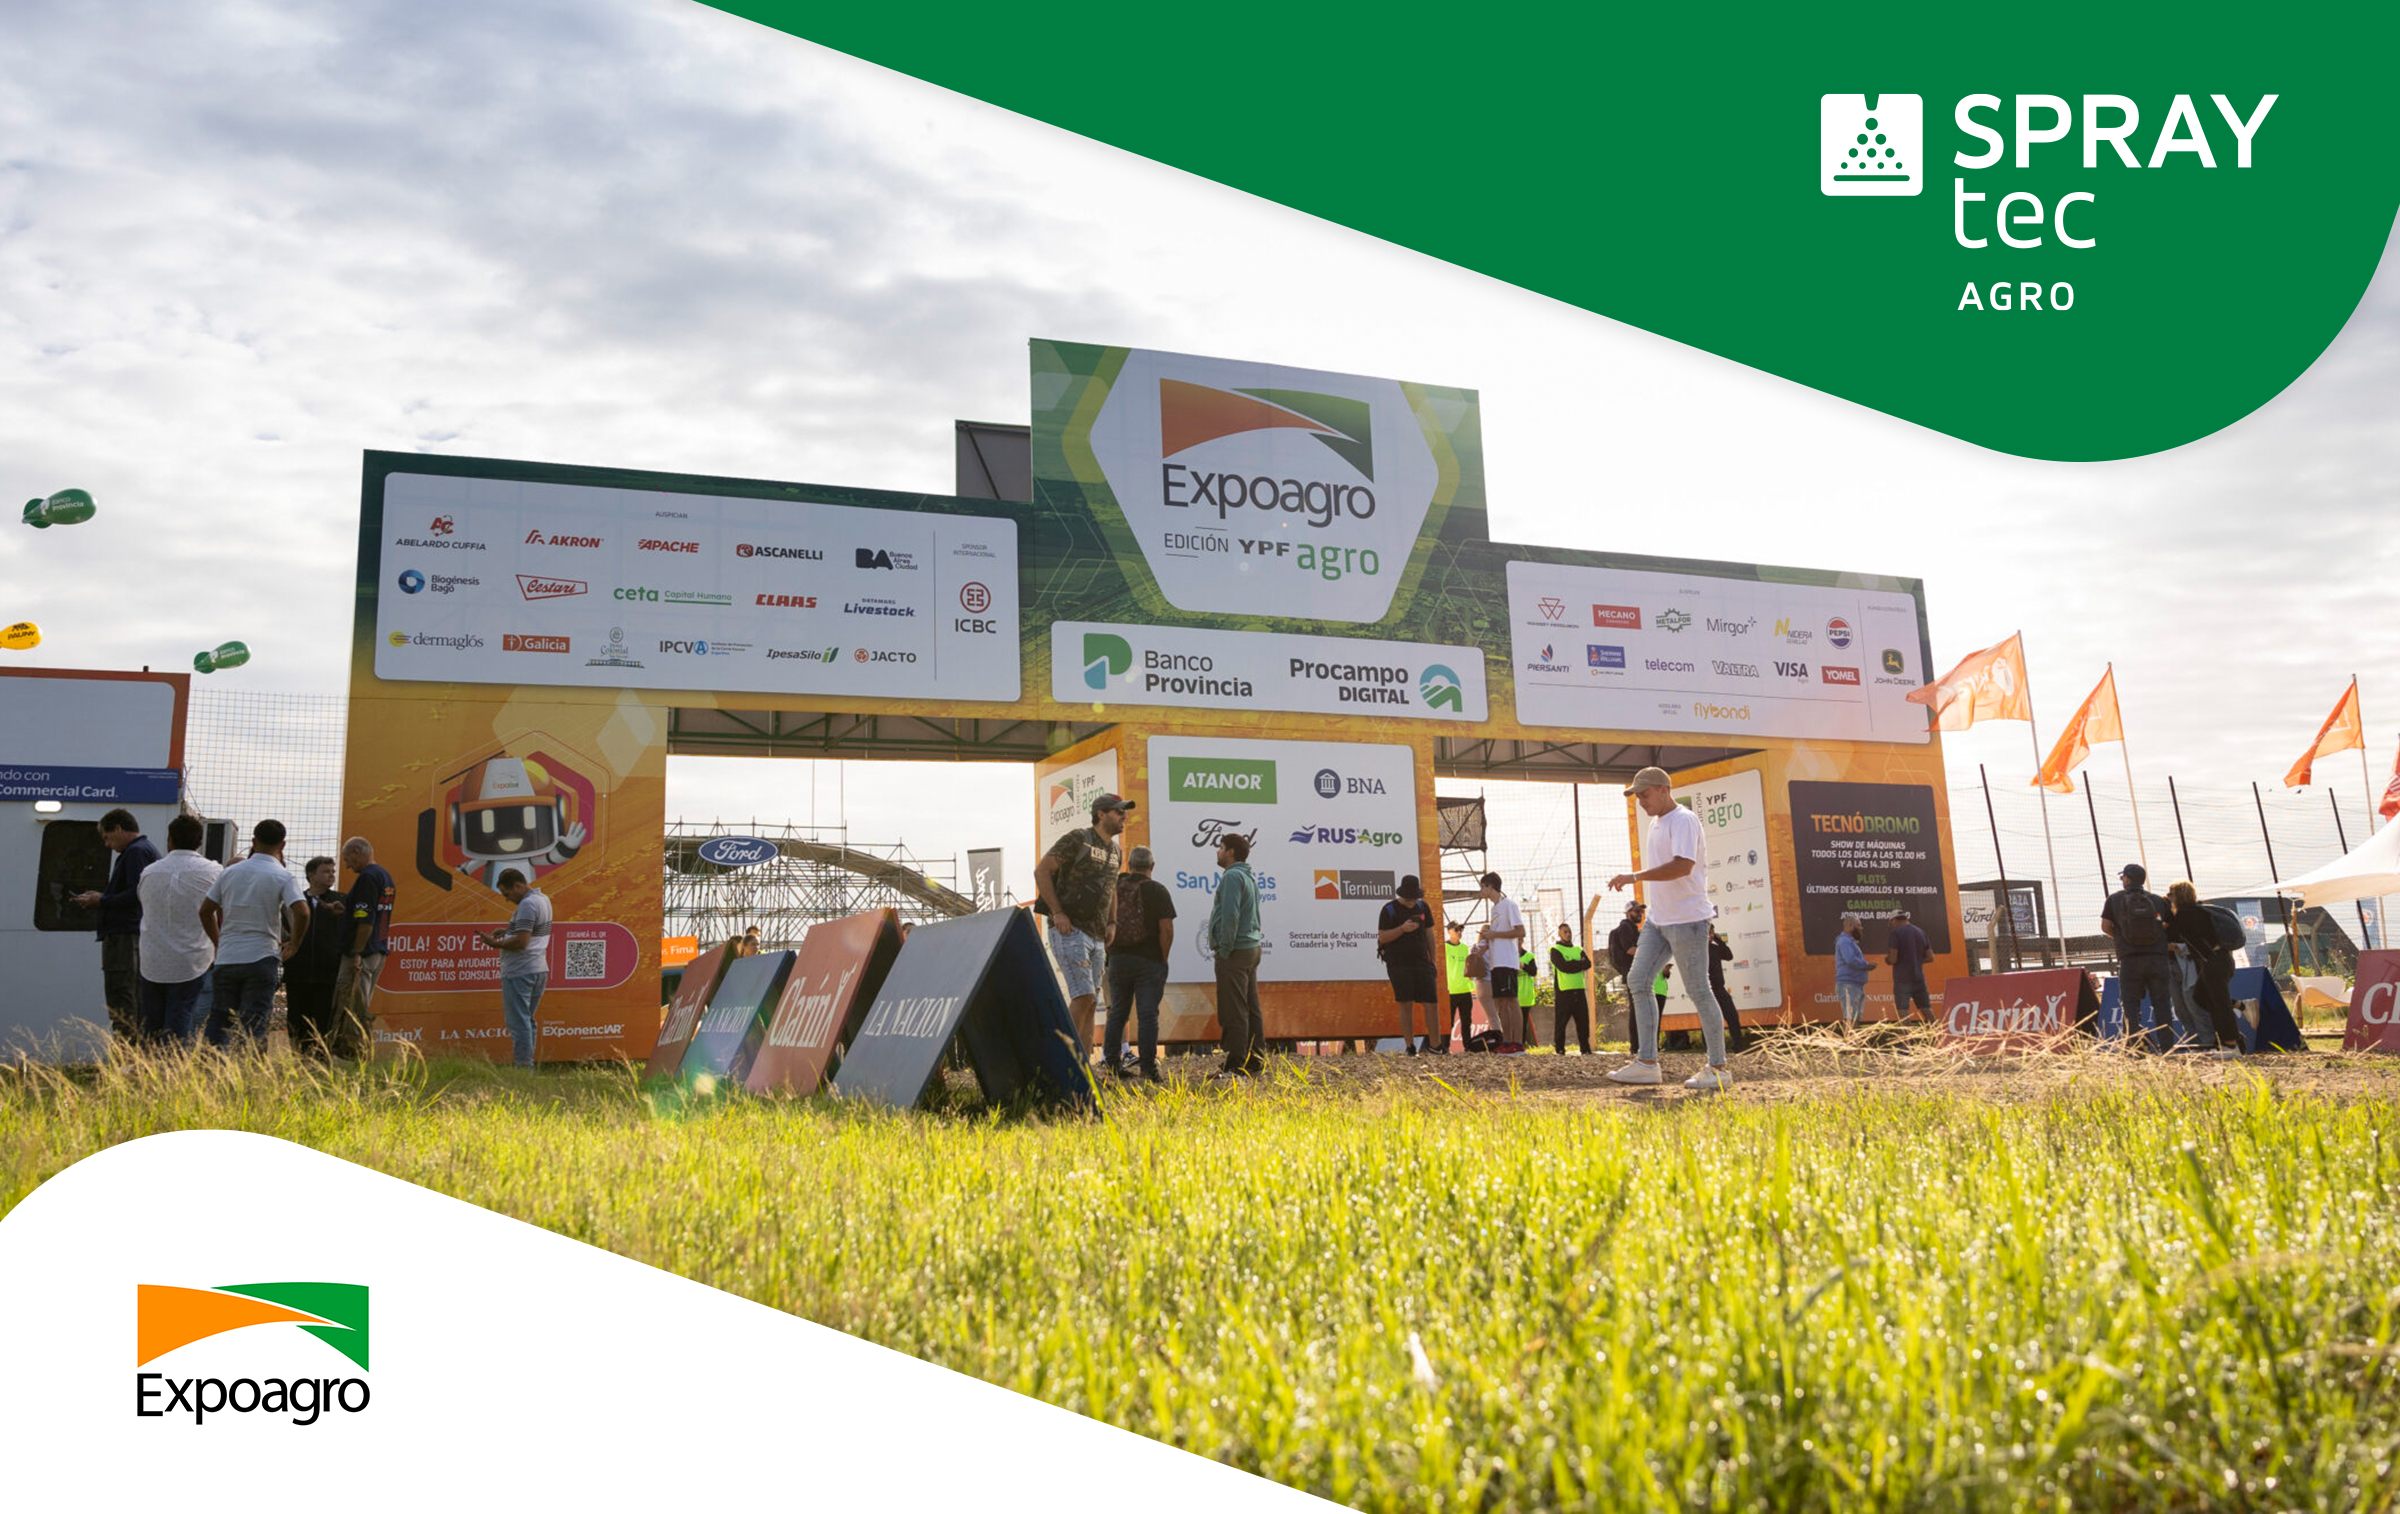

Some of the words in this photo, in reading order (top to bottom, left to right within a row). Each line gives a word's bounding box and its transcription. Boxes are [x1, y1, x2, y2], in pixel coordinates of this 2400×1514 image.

[1162, 462, 1376, 528] Expoagro
[396, 538, 450, 549] ABELARDO
[452, 541, 486, 551] CUFFIA
[549, 535, 600, 548] AKRON
[640, 539, 699, 553] APACHE
[755, 546, 823, 560] ASCANELLI
[1164, 532, 1229, 553] EDICIÓN
[1238, 538, 1290, 556] YPF
[1297, 542, 1380, 580] agro
[431, 574, 480, 586] Biogénesis
[526, 579, 576, 594] Cestari
[431, 583, 455, 594] Bagó
[613, 587, 659, 602] ceta
[755, 593, 817, 608] CLAAS
[844, 603, 916, 617] Livestock
[1597, 610, 1636, 620] MECANO
[955, 618, 997, 634] ICBC
[1706, 617, 1749, 637] Mirgor
[1829, 629, 1851, 637] PEPSI
[413, 632, 484, 650] dermaglós
[525, 637, 567, 651] Galicia
[766, 648, 822, 661] IpesaSilo
[871, 651, 917, 664] JACTO
[1144, 650, 1214, 673] Banco
[1289, 657, 1409, 686] Procampo
[1527, 663, 1570, 673] PIERSANTI
[1645, 658, 1695, 673] telecom
[1712, 660, 1760, 678] VALTRA
[1773, 661, 1809, 678] VISA
[1825, 670, 1857, 682] YOMEL
[1145, 673, 1253, 697] Provincia
[1339, 686, 1410, 705] DIGITAL
[1694, 702, 1751, 720] flybondi
[24, 771, 50, 781] con
[1082, 775, 1095, 789] YPF
[1183, 772, 1261, 790] ATANOR
[1347, 778, 1386, 795] BNA
[1706, 793, 1727, 805] YPF
[1707, 802, 1743, 828] agro
[1811, 811, 1920, 834] TECNÓDROMO
[1192, 818, 1258, 848] Fod
[1318, 828, 1356, 844] RUS
[1357, 829, 1403, 847] Agro
[714, 840, 763, 860] Ford
[1831, 840, 1854, 849] SHOW
[1855, 841, 1864, 849] DE
[1867, 840, 1906, 850] MÁQUINAS
[1811, 850, 1836, 858] TODOS
[1855, 850, 1871, 859] DÍAS
[1873, 851, 1878, 859] A
[1880, 851, 1893, 859] LAS
[1895, 851, 1914, 859] 10.00
[1176, 871, 1213, 894] San
[1857, 874, 1887, 884] PLOTS
[1342, 880, 1392, 896] Ternium
[1807, 884, 1839, 893] ÚLTIMOS
[1841, 886, 1892, 894] DESARROLLOS
[1906, 886, 1937, 894] SIEMBRA
[2008, 894, 2029, 906] AZA
[1964, 907, 1995, 923] Ford
[387, 936, 430, 952] HOLA!
[437, 936, 466, 951] SOY
[1330, 931, 1339, 940] de
[1341, 931, 1379, 942] Agricultur
[670, 945, 695, 955] Fima
[1337, 940, 1358, 949] Pesca
[400, 959, 428, 969] ESTOY
[431, 959, 454, 968] PARA
[457, 958, 500, 967] AYUDARTE
[409, 972, 436, 982] TODAS
[440, 972, 456, 981] TUS
[459, 971, 500, 980] CONSULTA
[865, 1001, 890, 1036] LA
[883, 997, 959, 1038] NACION
[1948, 995, 2041, 1036] Clarín
[441, 1029, 460, 1040] LA
[465, 1028, 511, 1039] NACIO
